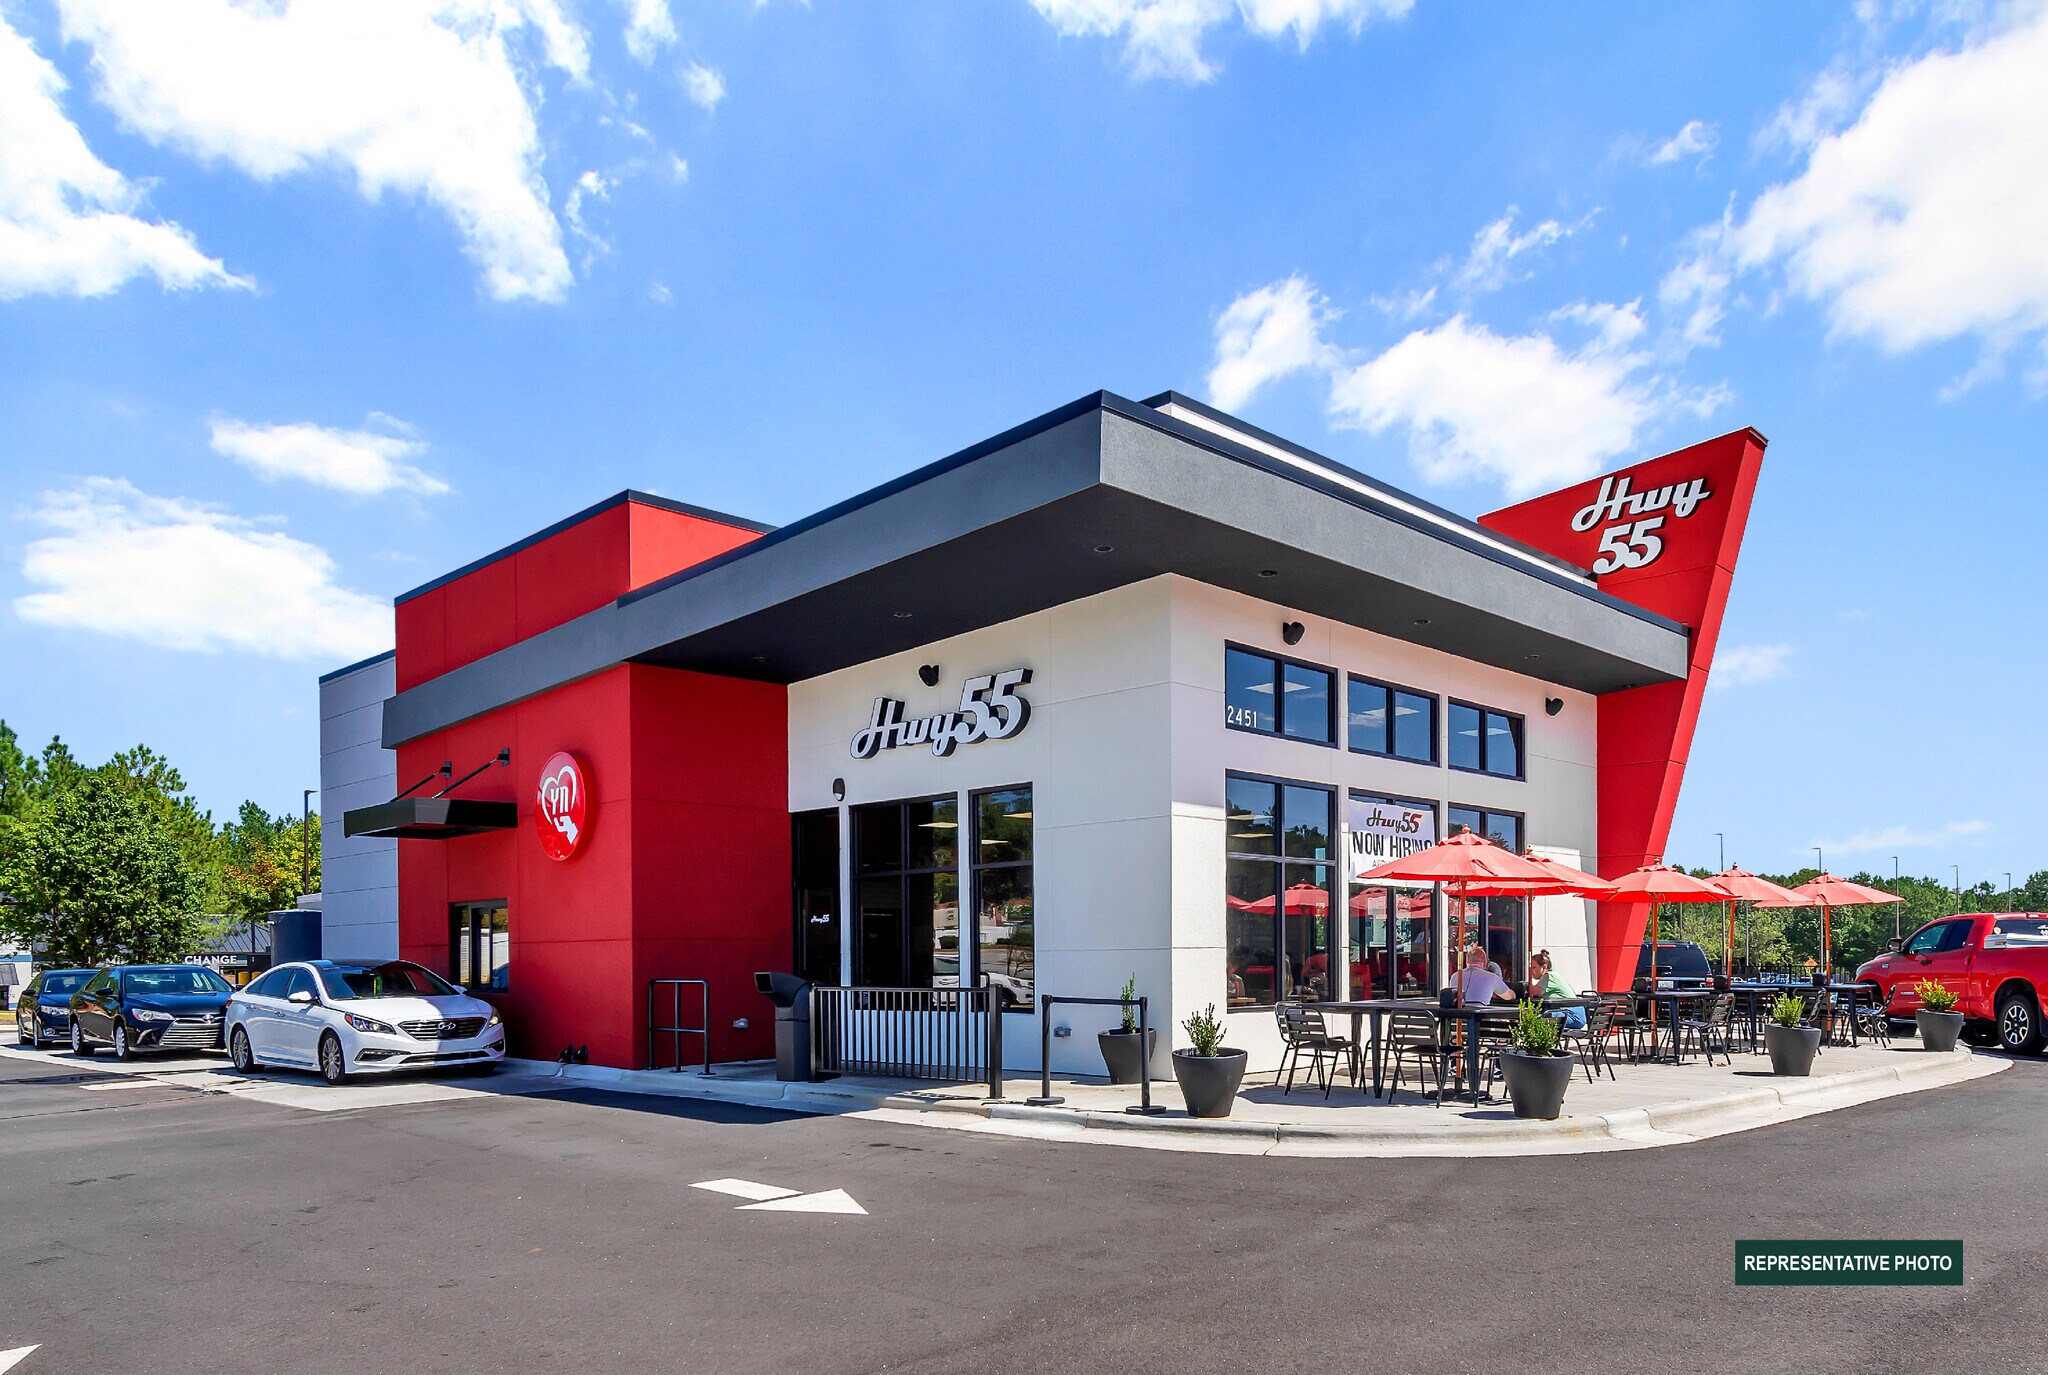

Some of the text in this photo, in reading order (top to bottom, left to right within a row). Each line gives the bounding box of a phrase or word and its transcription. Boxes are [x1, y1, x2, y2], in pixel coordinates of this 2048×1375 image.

[1571, 476, 1711, 532] Hwy
[1592, 516, 1666, 574] 55
[1227, 704, 1257, 728] 2451
[1352, 831, 1384, 856] NOW
[184, 955, 237, 965] CHANGE
